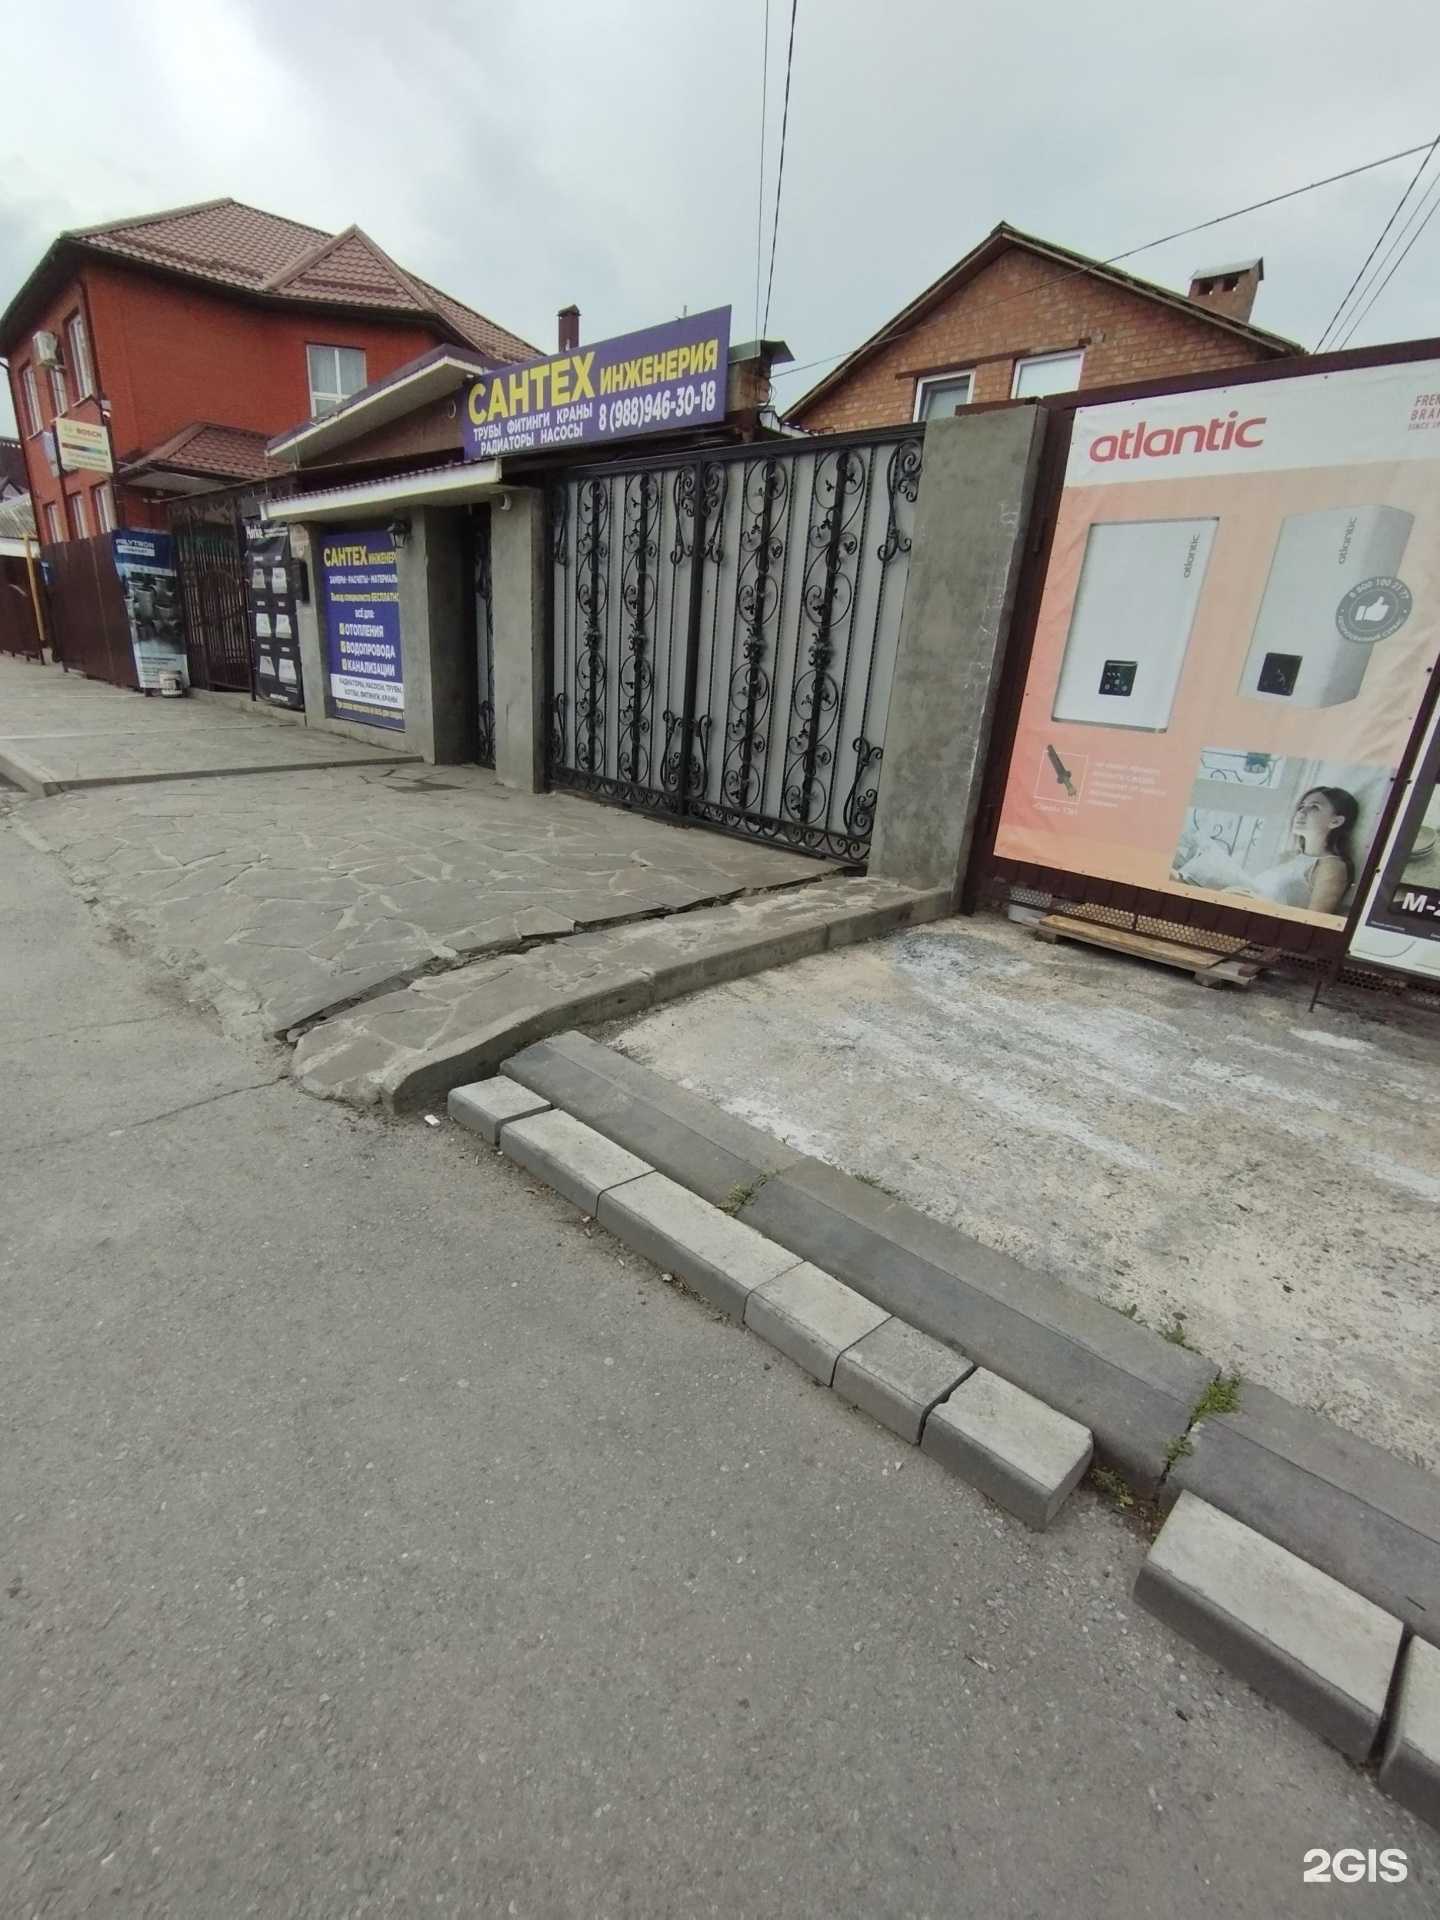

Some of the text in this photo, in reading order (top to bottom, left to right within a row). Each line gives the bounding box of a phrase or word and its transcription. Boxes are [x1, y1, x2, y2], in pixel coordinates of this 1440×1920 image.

[468, 337, 718, 425] САНТЕХ ИНЖЕНЕРИЯ
[473, 402, 592, 442] ТРУБЫ ФИТИНГИ КРАНЫ
[599, 380, 716, 431] 8 (988)946-30-18
[480, 423, 583, 456] РАДИАТОРЫ НАСОСЫ
[1090, 410, 1266, 463] atlantic
[323, 545, 368, 567] САНТЕХ
[1184, 532, 1201, 578] atlantic
[345, 623, 384, 638] ОТОПЛЕНИЯ
[346, 641, 396, 660] ВОДОПРОВОДА
[347, 659, 396, 677] КАНАЛИЗАЦИИ
